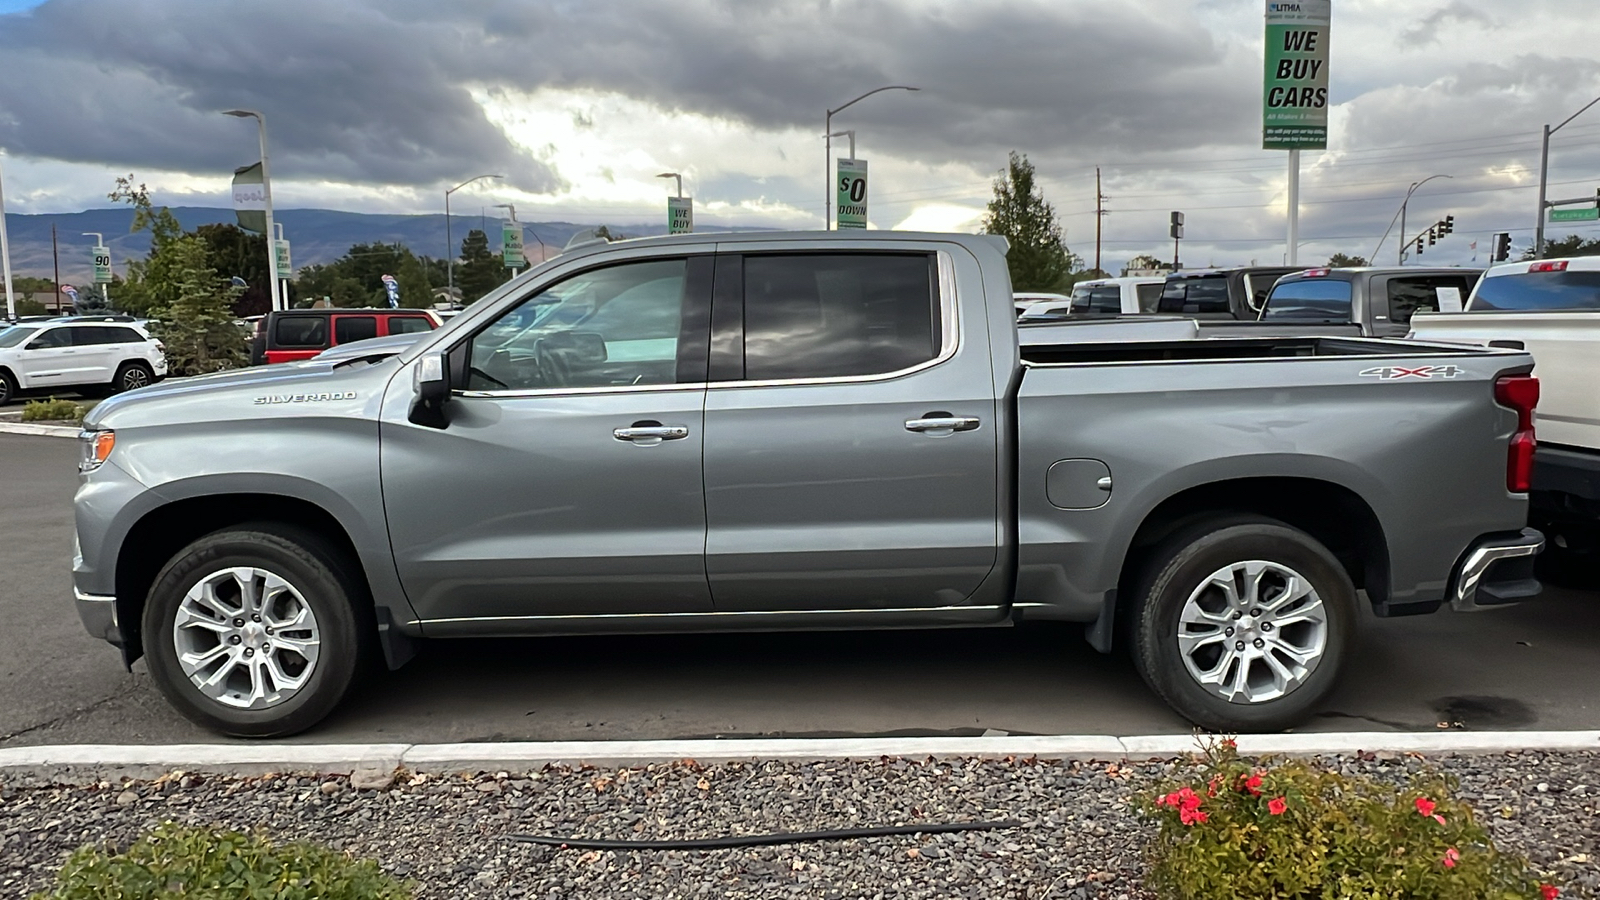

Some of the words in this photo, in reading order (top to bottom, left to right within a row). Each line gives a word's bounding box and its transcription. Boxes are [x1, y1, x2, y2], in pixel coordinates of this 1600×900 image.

[1276, 4, 1301, 12] LITHIA
[1284, 31, 1318, 51] WE
[1276, 59, 1322, 79] BUY
[1268, 87, 1327, 108] CARS
[840, 177, 866, 203] $0
[675, 209, 688, 218] WE
[838, 205, 866, 216] DOWN
[672, 220, 690, 229] BUY
[95, 255, 110, 266] 90
[253, 391, 357, 405] SILVERADO
